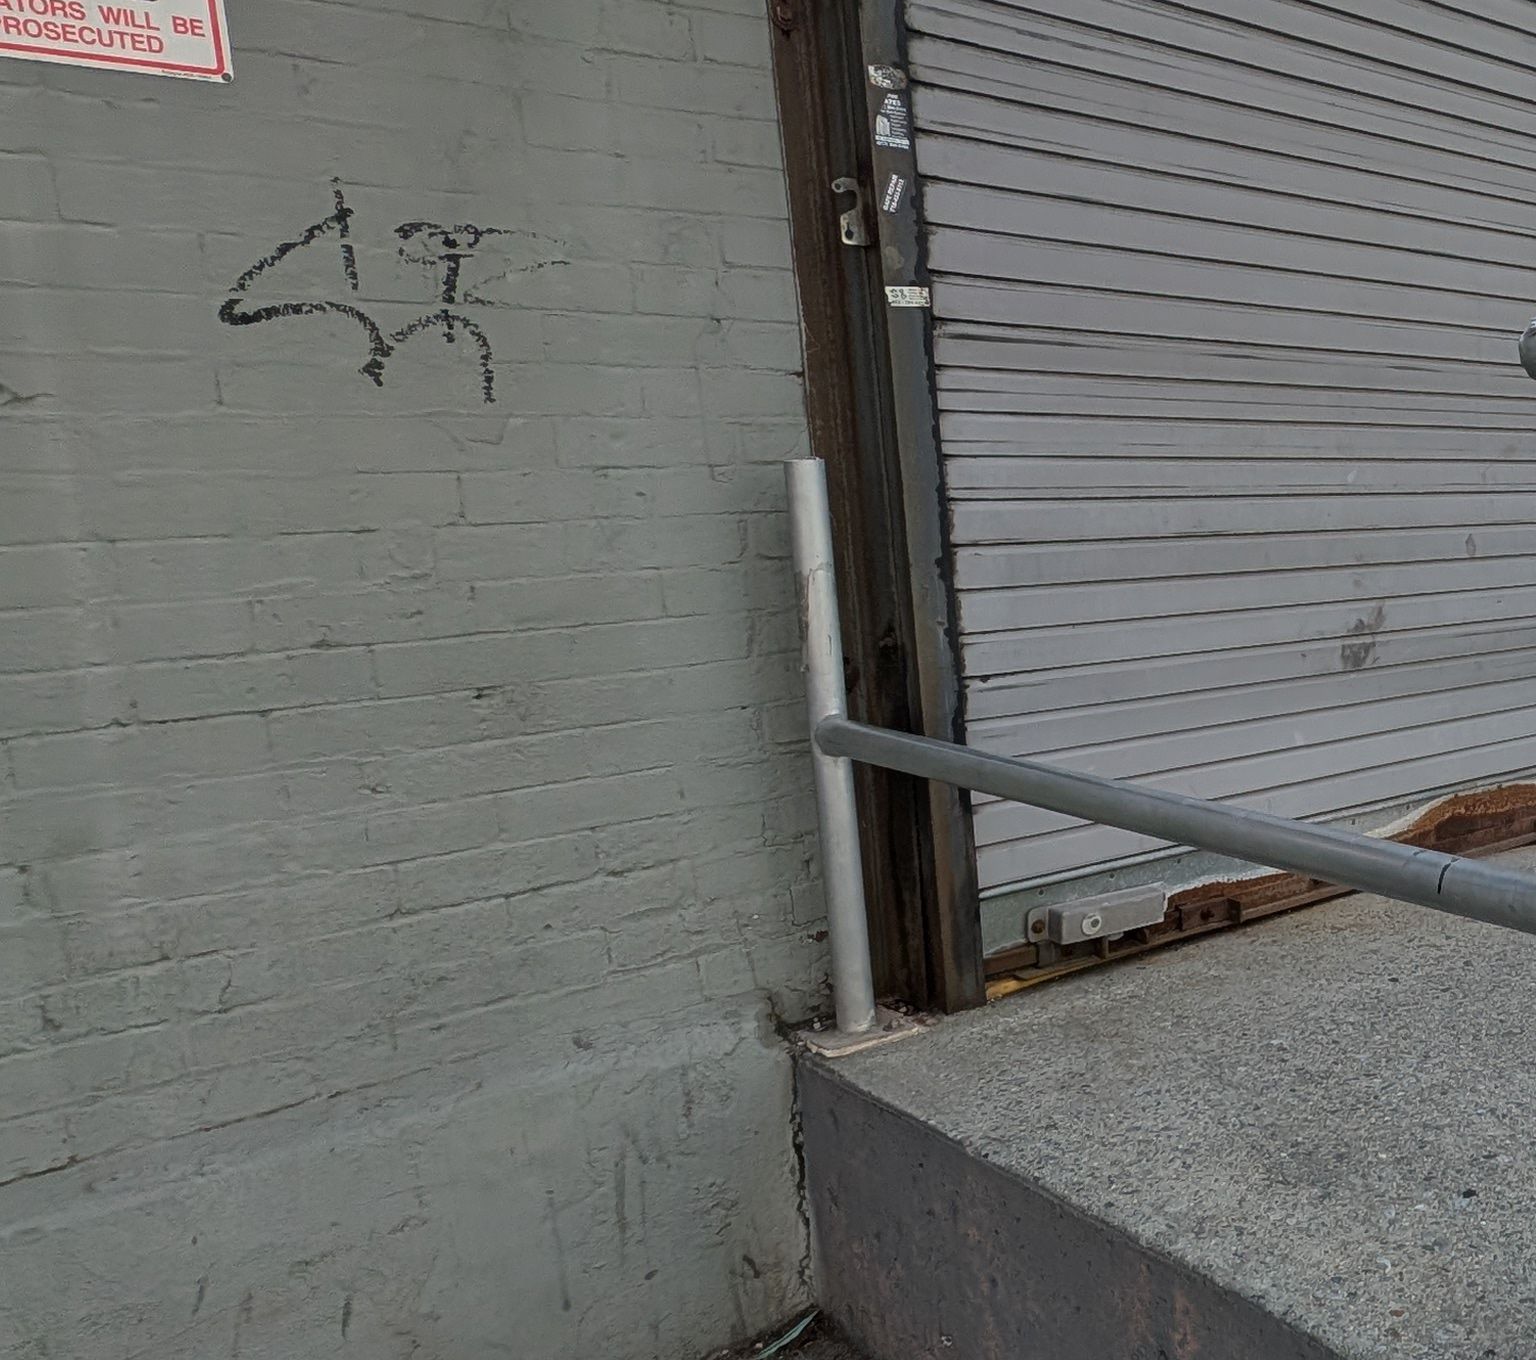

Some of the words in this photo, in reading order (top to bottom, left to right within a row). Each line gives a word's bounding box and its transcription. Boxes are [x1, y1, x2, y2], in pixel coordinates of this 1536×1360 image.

[0, 15, 164, 54] ROSECUTED
[99, 5, 160, 32] WILL
[172, 15, 206, 38] BE
